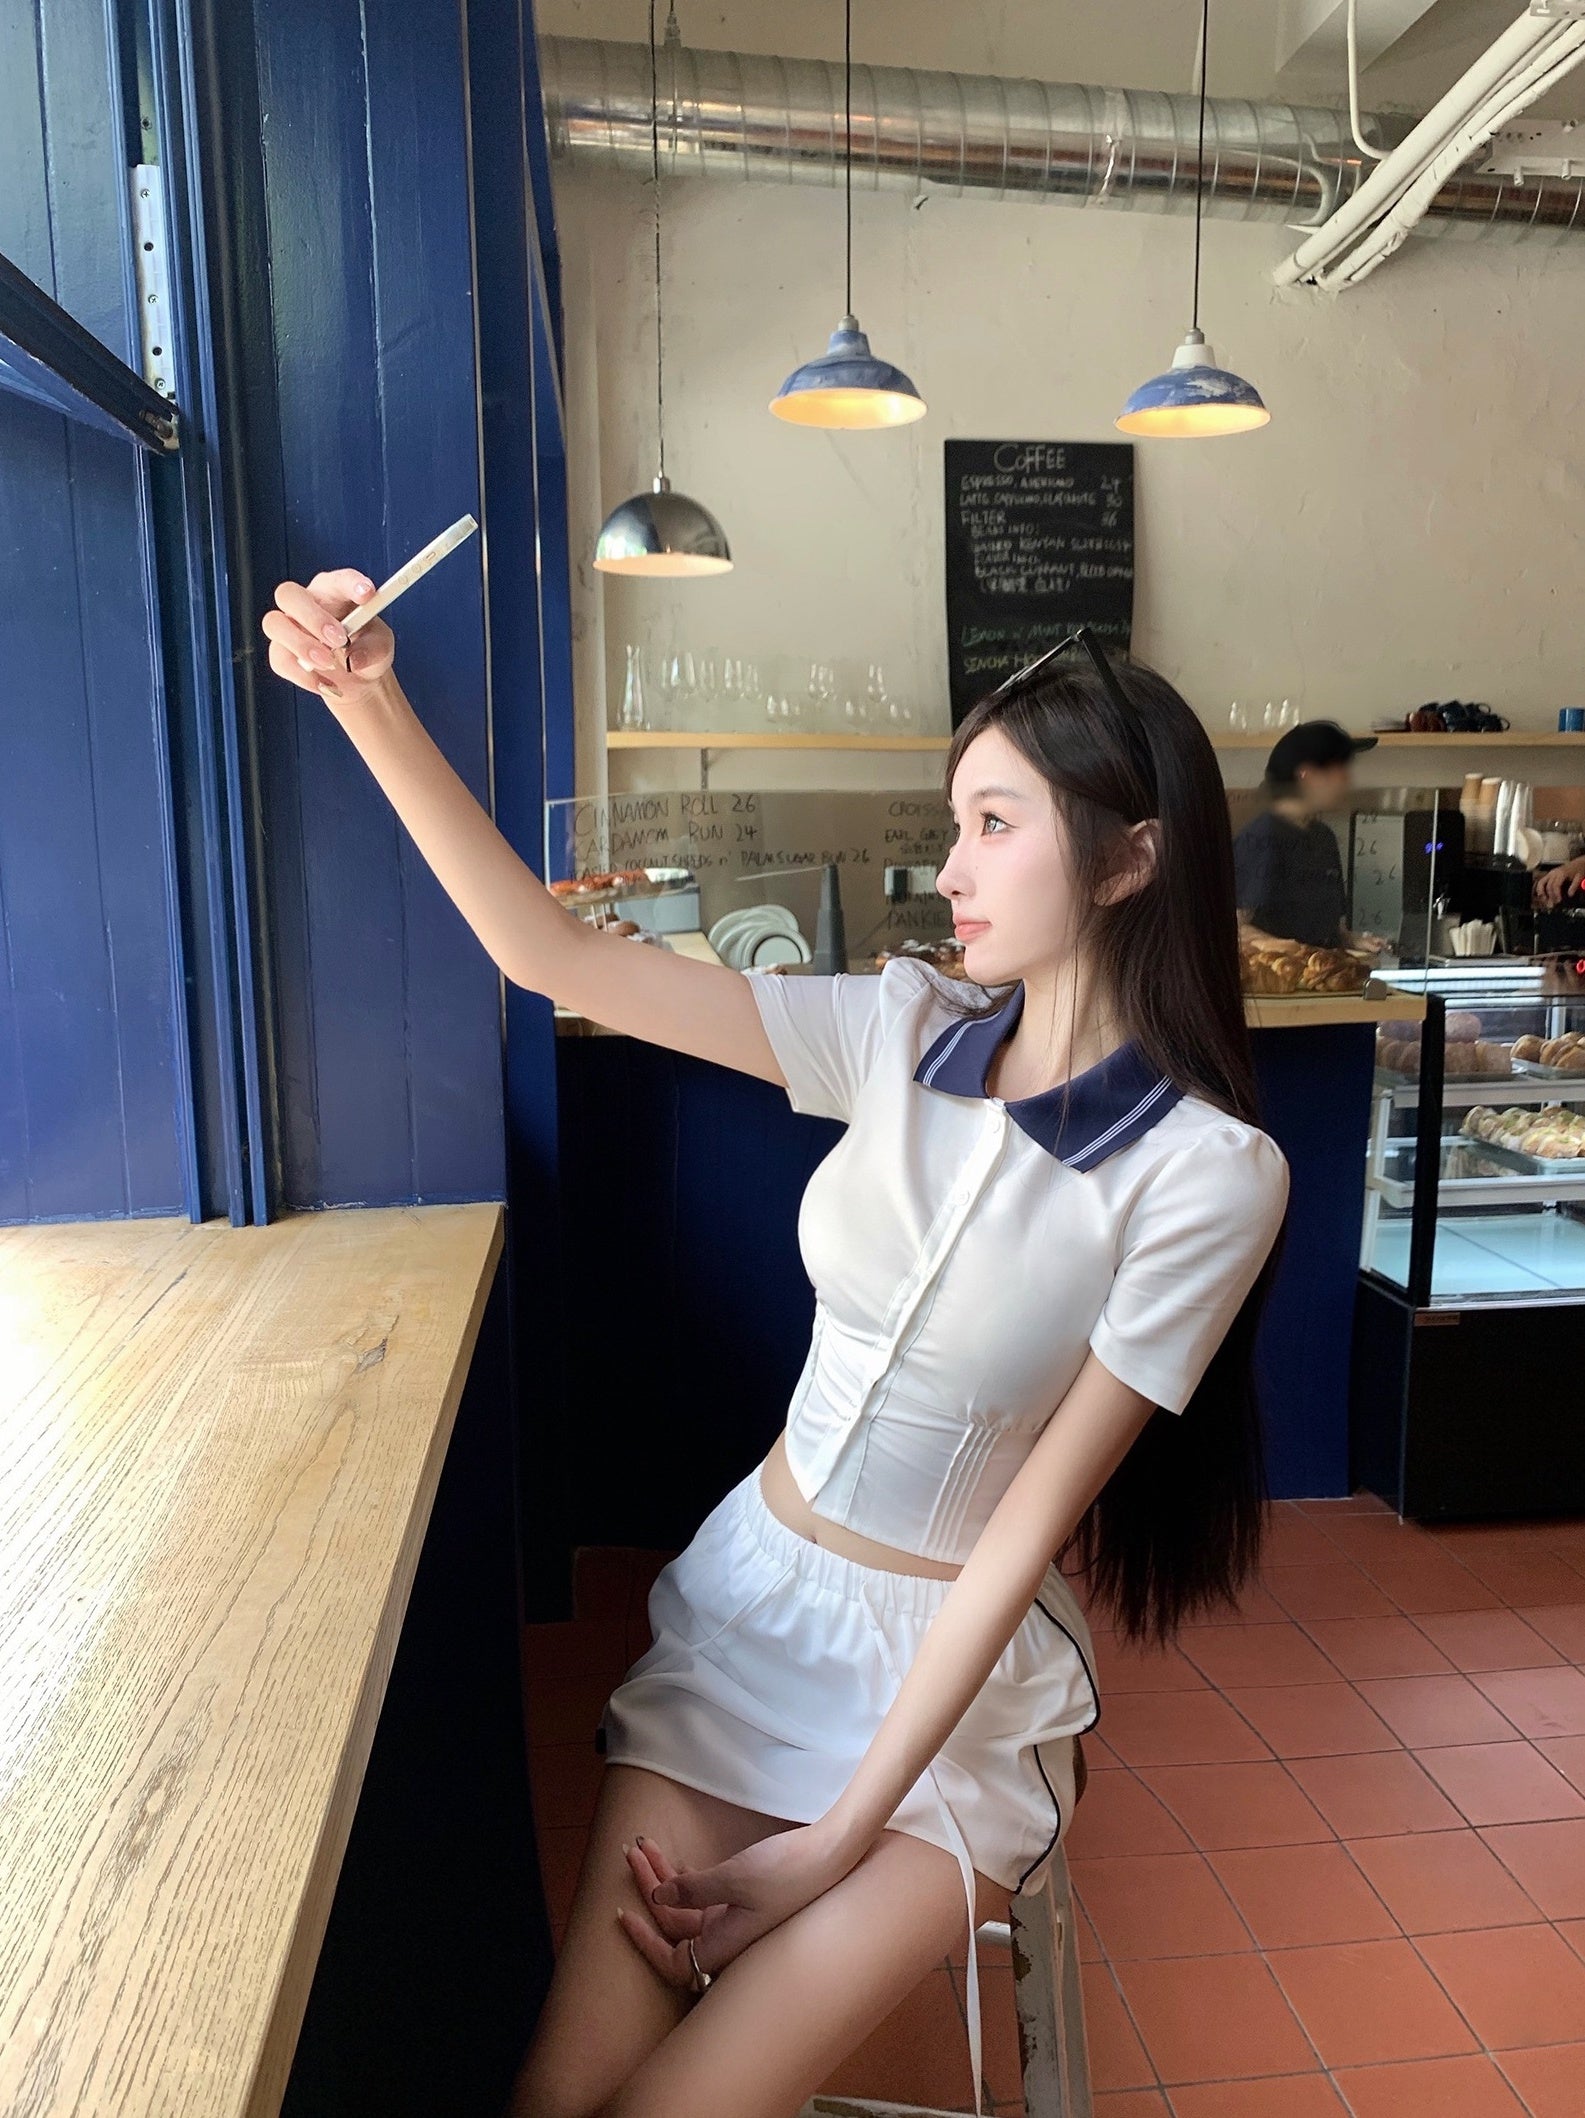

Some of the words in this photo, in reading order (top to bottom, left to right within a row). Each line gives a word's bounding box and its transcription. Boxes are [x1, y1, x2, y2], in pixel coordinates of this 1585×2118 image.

[681, 794, 718, 816] ROLL
[732, 794, 756, 813] 26
[736, 824, 758, 842] 24
